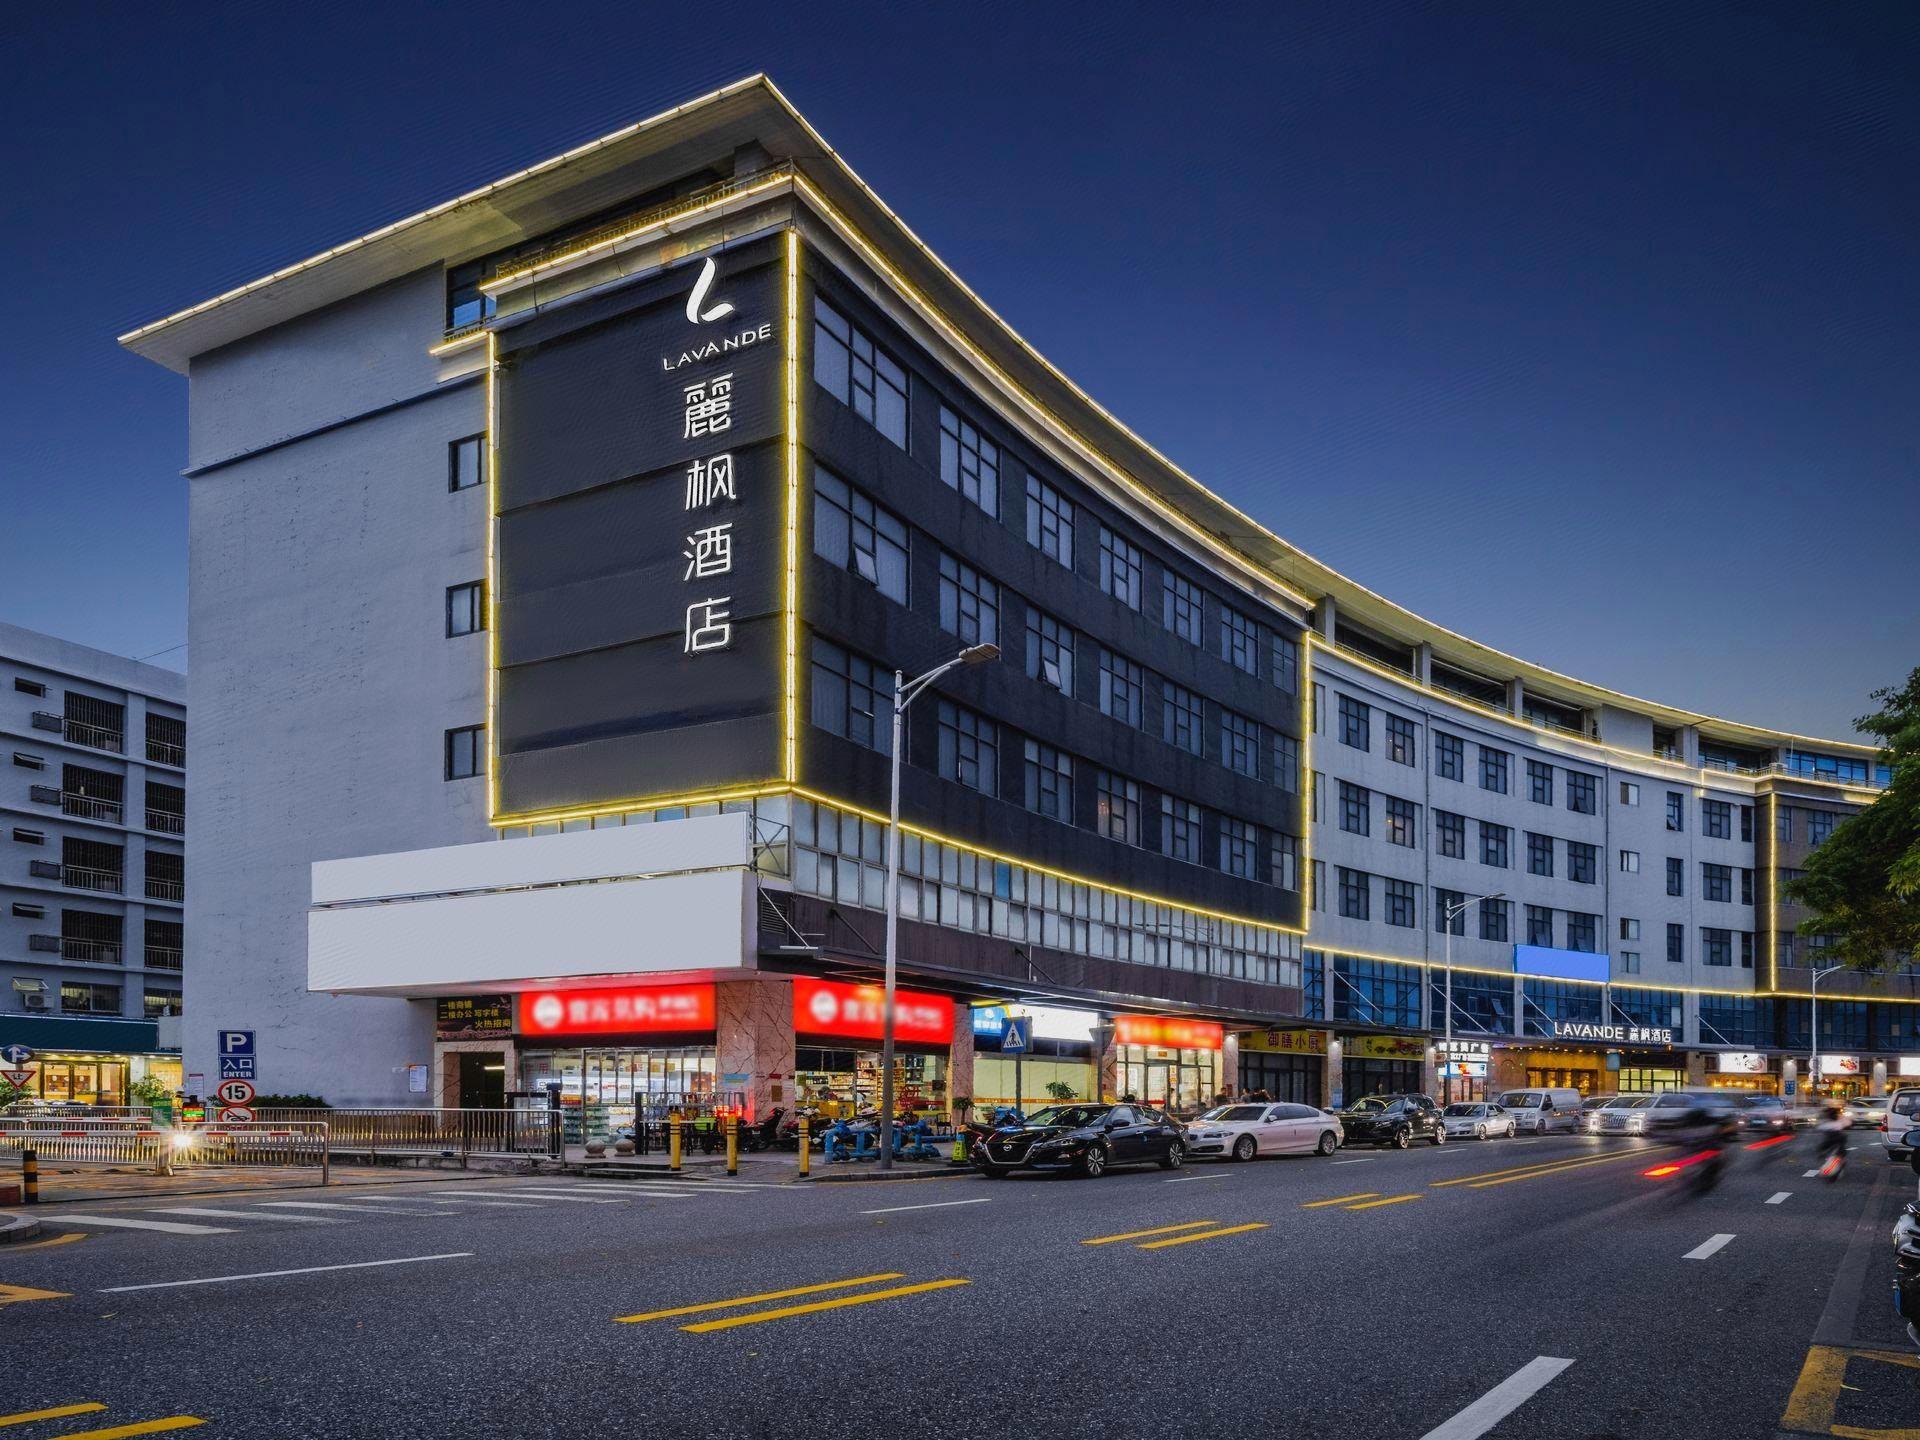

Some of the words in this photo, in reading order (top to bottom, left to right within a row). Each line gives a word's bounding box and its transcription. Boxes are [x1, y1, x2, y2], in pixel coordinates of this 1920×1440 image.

[662, 323, 773, 371] LAVANDE
[683, 372, 737, 655] 麗枫酒店
[1266, 1030, 1321, 1050] 御膳小厨
[1554, 1021, 1625, 1040] LAVANDE
[226, 1033, 248, 1053] P
[223, 1058, 254, 1070] 入口
[225, 1085, 246, 1100] 15
